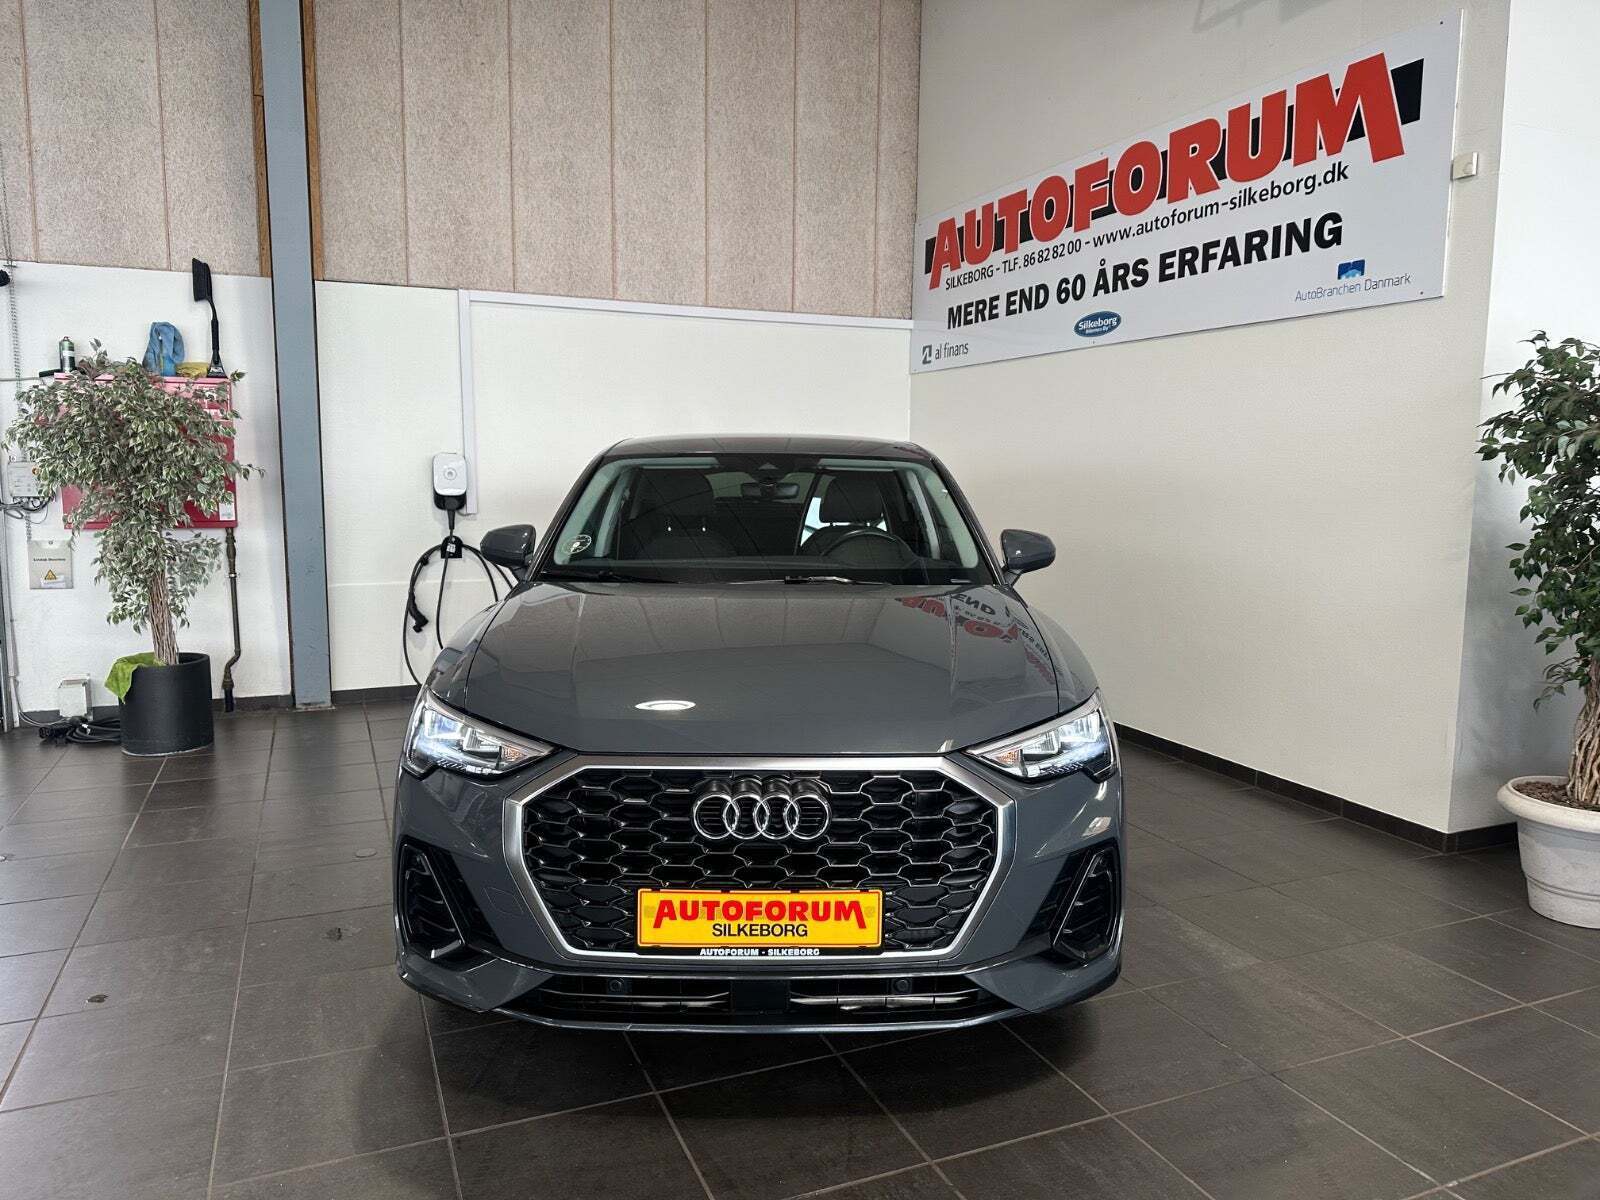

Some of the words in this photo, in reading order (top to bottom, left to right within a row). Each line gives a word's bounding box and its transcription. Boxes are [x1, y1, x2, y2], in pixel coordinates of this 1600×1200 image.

[928, 52, 1405, 290] AUTOFORUM
[945, 264, 994, 291] SILKEBORG
[1002, 257, 1022, 274] TLF.
[1092, 161, 1350, 248] www.autoforum-silkeborg.dk
[947, 295, 1000, 330] MERE
[1005, 283, 1050, 317] END
[1056, 273, 1086, 304] 60
[1092, 258, 1149, 298] ÅRS
[1158, 211, 1343, 284] ERFARING
[1295, 281, 1361, 302] AutoBranchen
[1364, 273, 1412, 292] Danmark
[1078, 316, 1118, 331] Silkeborg
[935, 343, 942, 360] al
[944, 341, 969, 358] finans
[653, 900, 867, 930] AUTOFORUM
[712, 923, 808, 937] SILKEBORG
[700, 948, 759, 957] AUTOFORUM
[768, 948, 820, 957] SILKEBORG
